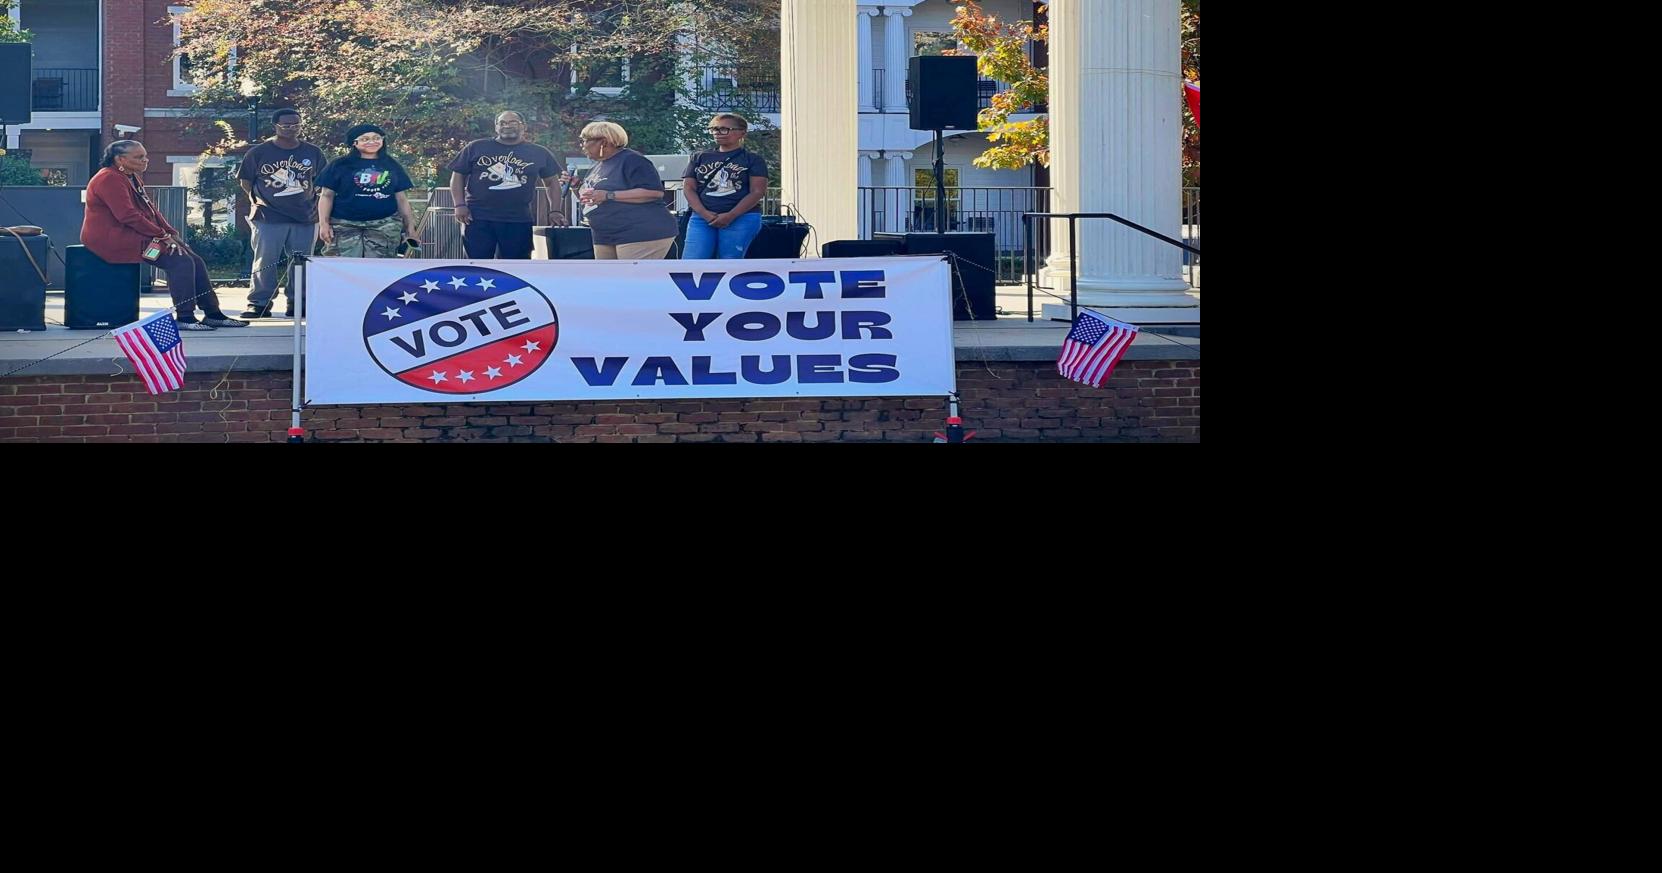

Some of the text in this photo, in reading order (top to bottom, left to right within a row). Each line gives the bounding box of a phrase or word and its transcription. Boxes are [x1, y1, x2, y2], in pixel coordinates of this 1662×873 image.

[477, 151, 534, 169] Overload
[669, 270, 886, 300] VOTE
[389, 300, 530, 358] VOTE
[669, 311, 893, 341] YOUR
[570, 353, 900, 386] VALUES
